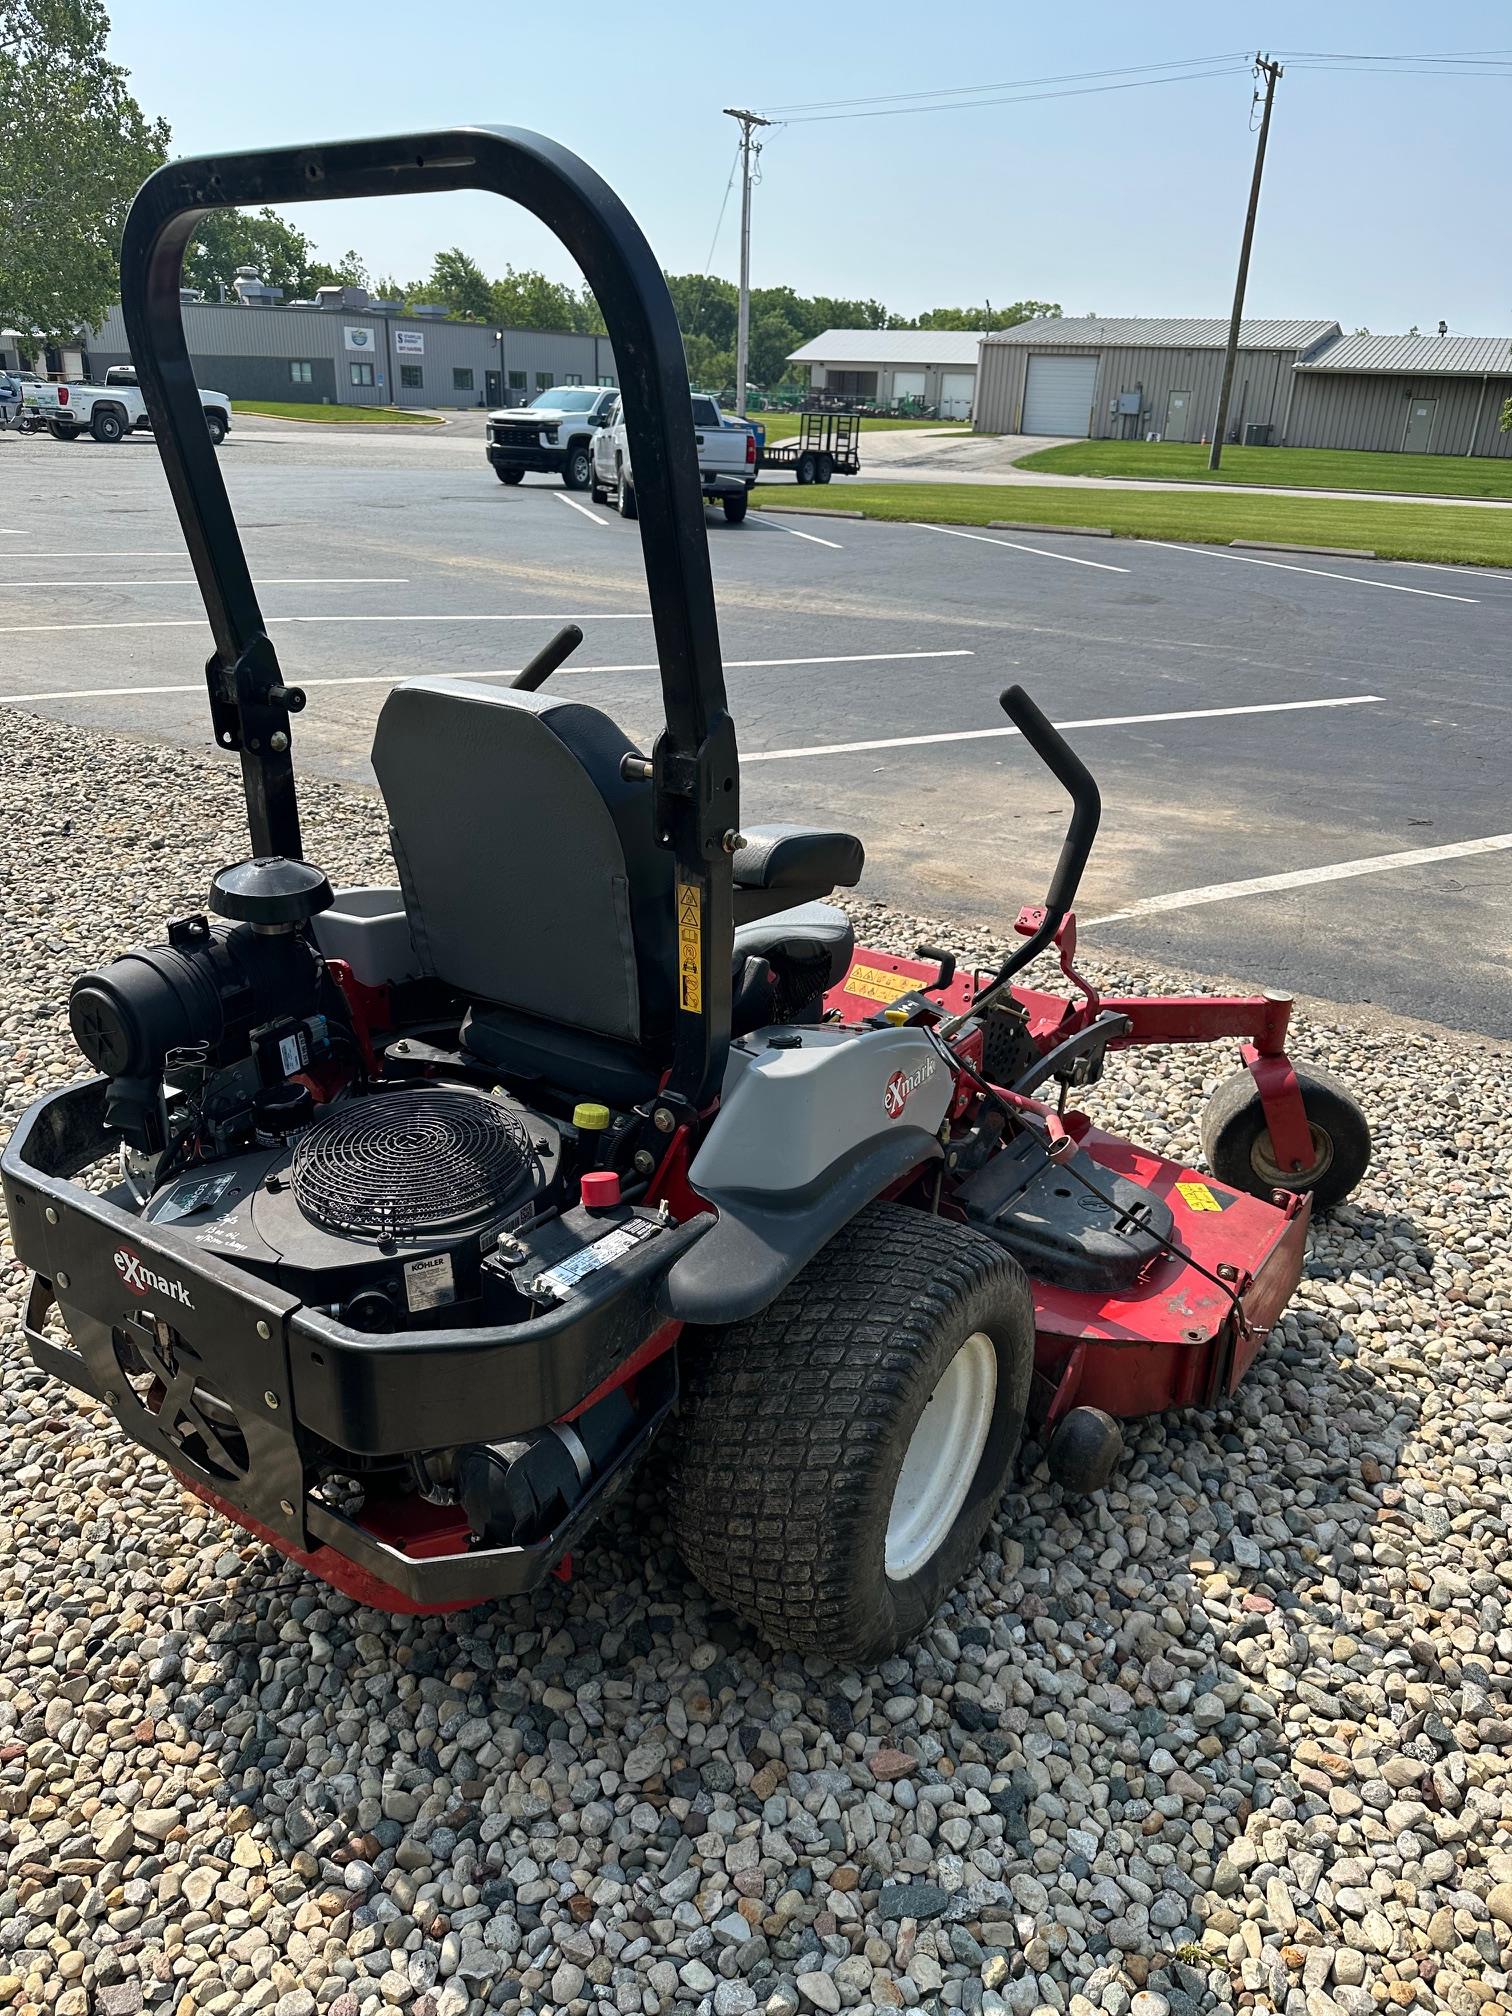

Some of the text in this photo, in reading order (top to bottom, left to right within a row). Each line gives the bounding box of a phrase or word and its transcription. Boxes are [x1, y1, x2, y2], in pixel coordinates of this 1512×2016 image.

[883, 1056, 935, 1114] eXmark
[113, 1250, 194, 1309] eXmark
[411, 1258, 444, 1271] KOHLER
